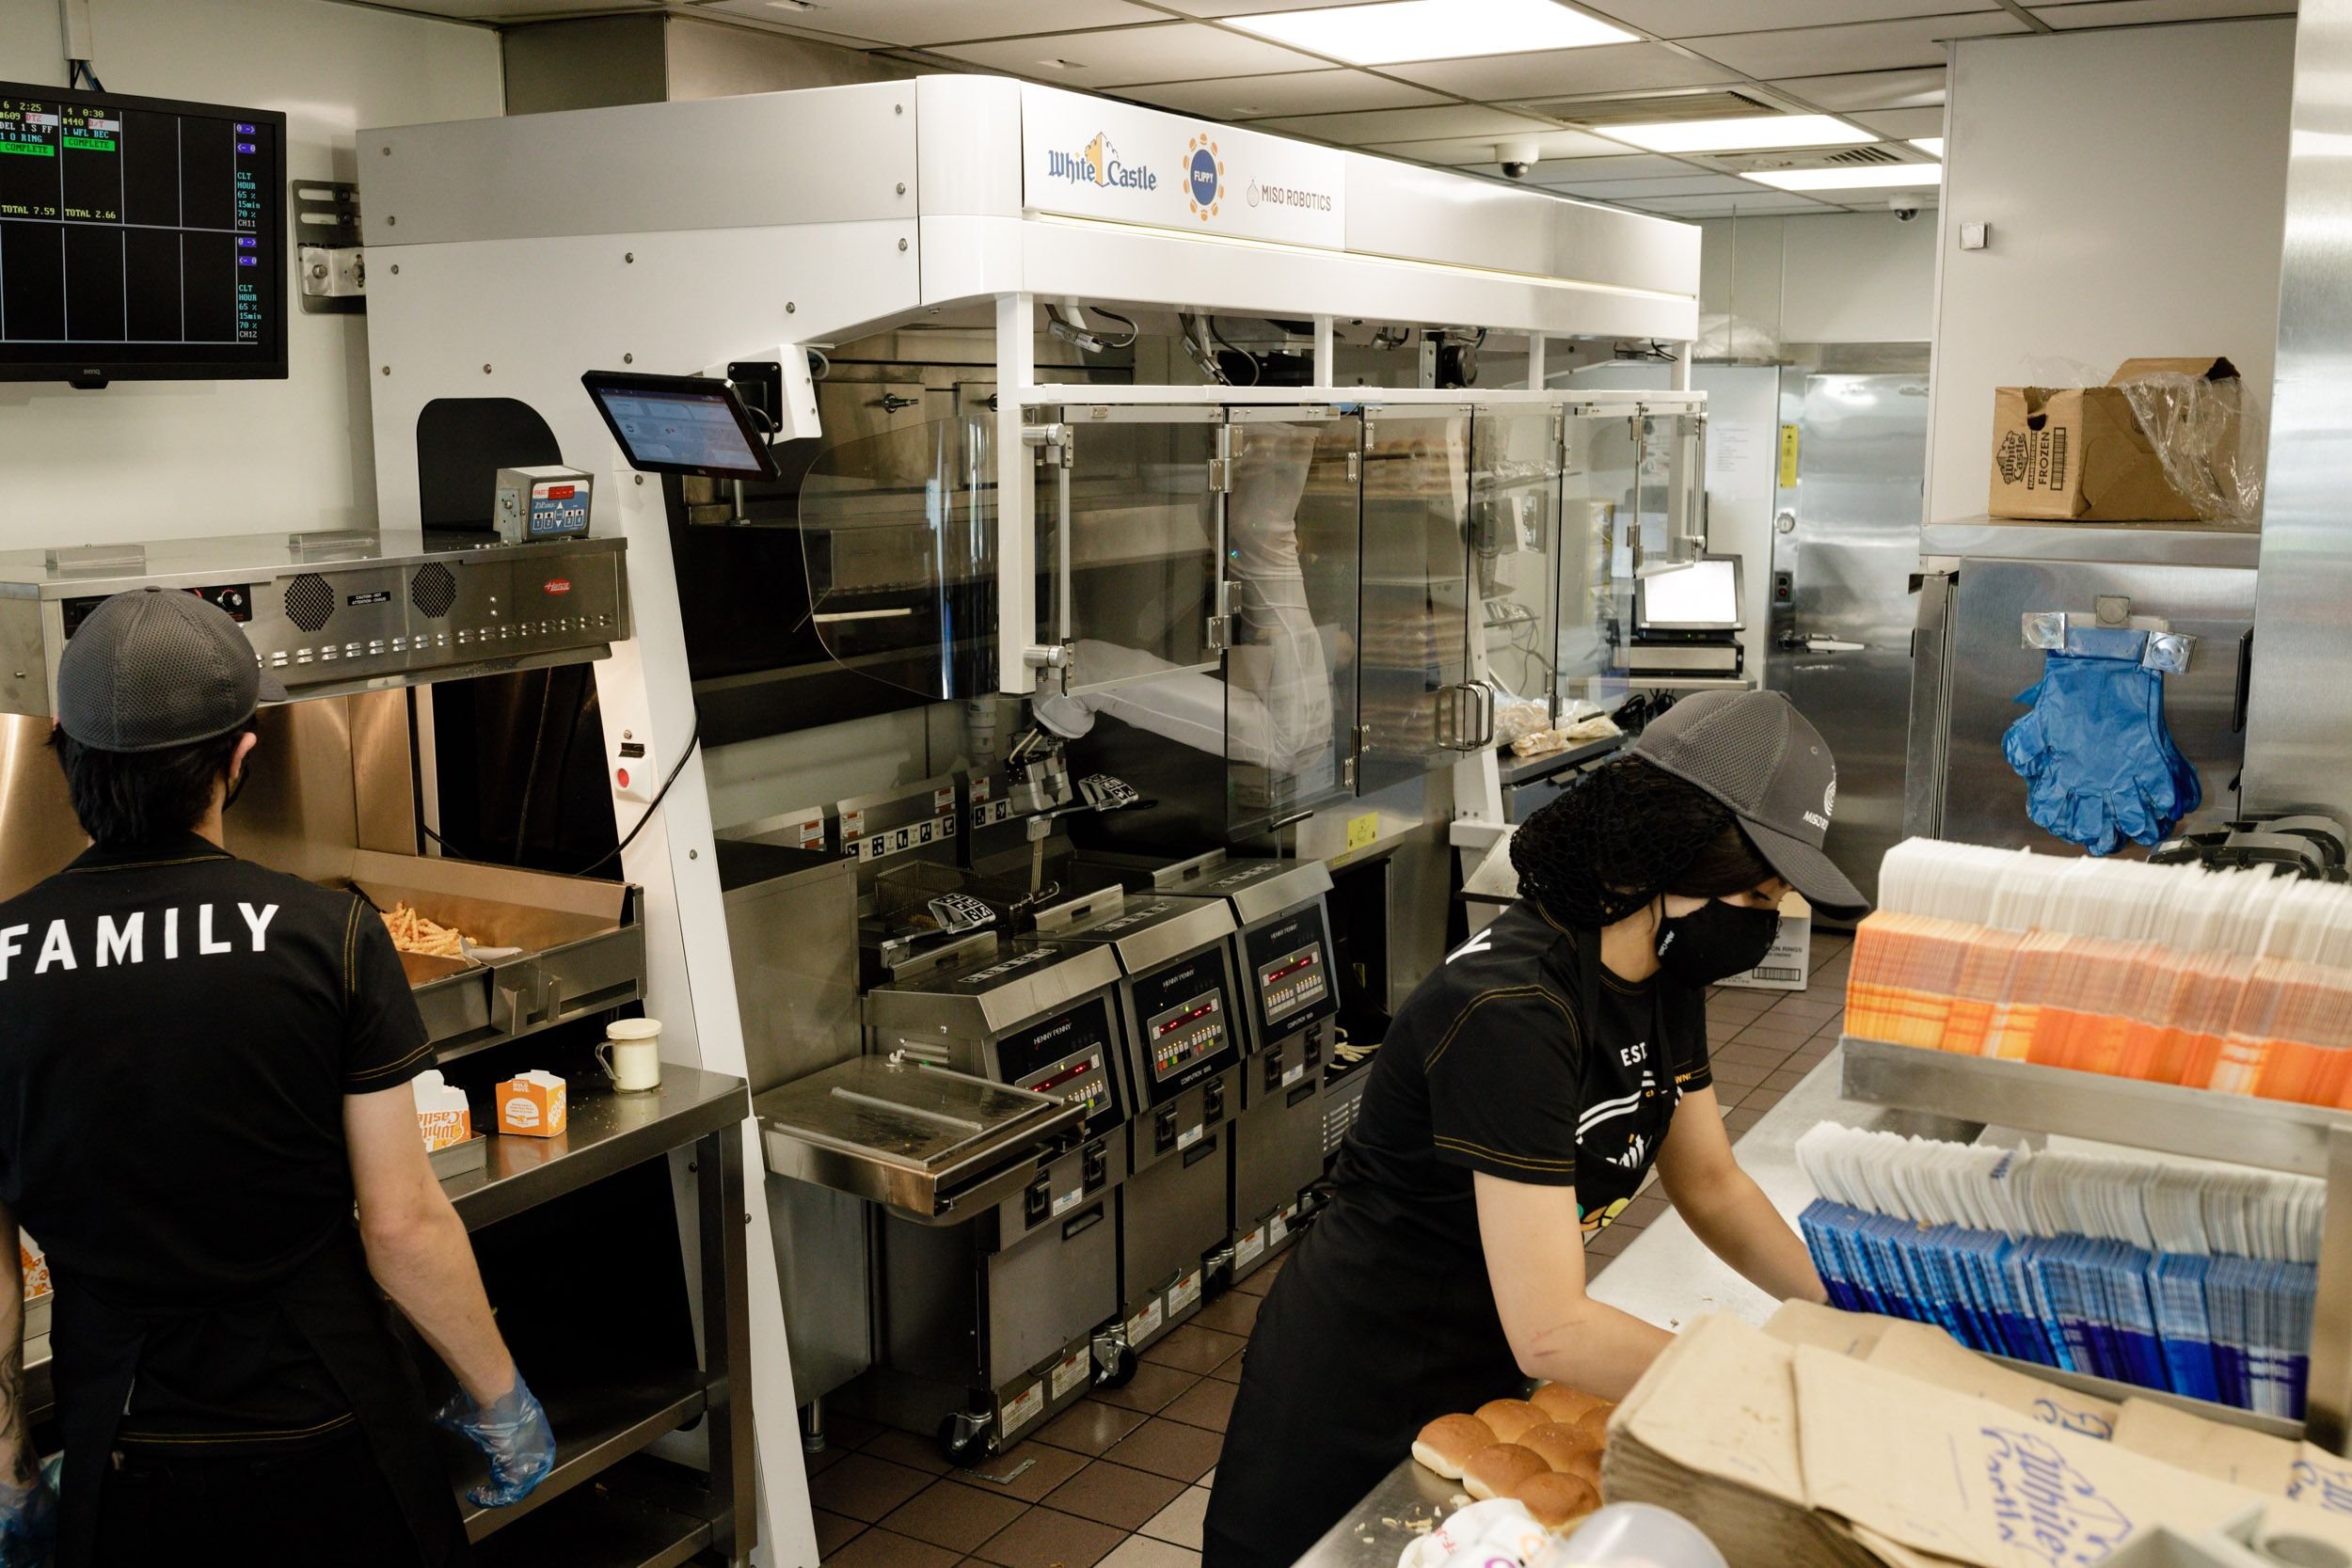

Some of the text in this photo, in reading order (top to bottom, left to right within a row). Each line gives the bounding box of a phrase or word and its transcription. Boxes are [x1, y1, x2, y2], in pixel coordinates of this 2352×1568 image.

[4, 101, 42, 112] 6 2:25
[83, 108, 104, 118] 0:30
[42, 125, 53, 134] FF
[94, 130, 109, 138] BEC
[21, 134, 42, 143] RING
[68, 138, 109, 149] COMPLETE
[5, 142, 48, 153] COMPLETE
[237, 171, 251, 181] CLT
[1048, 150, 1156, 191] White Castle
[1194, 170, 1214, 183] FLIPPY
[237, 181, 256, 190] HOUR
[238, 199, 261, 209] 15min
[1262, 184, 1332, 213] MISO ROBOTICS
[2, 204, 56, 215] TOTAL 7.59
[65, 208, 117, 219] TOTAL 2.66
[237, 209, 247, 217] 70
[237, 219, 256, 228] CH11
[238, 284, 253, 293] CLT
[238, 302, 248, 310] 65
[239, 311, 262, 321] 15min
[239, 321, 249, 329] 70
[239, 330, 258, 339] CH12
[2005, 436, 2016, 477] White
[2014, 436, 2025, 480] Castle
[2039, 432, 2050, 484] FROZEN
[0, 903, 279, 981] FAMILY
[1162, 968, 1196, 988] HENNY PENNY
[1033, 1022, 1073, 1046] HENNY PENNY
[422, 1124, 454, 1140] Whit
